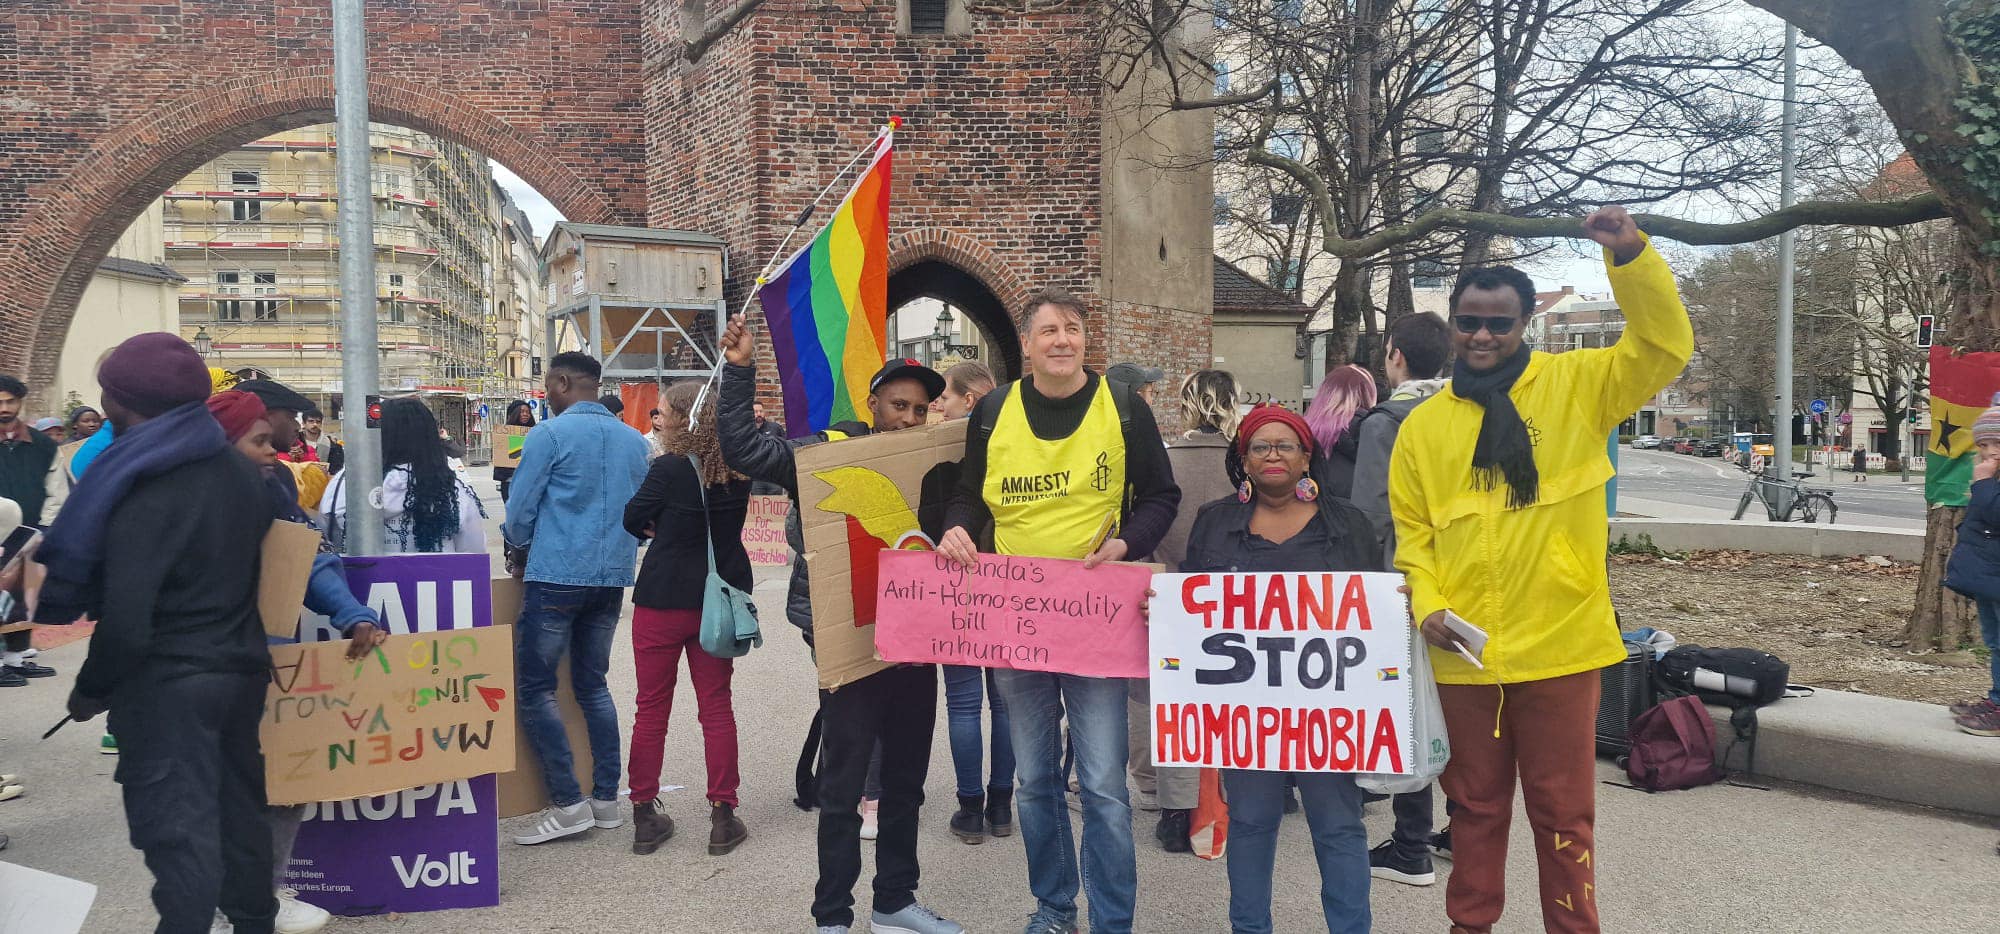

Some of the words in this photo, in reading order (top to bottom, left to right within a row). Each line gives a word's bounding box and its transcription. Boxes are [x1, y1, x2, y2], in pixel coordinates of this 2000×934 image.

[1001, 470, 1070, 494] AMNESTY
[1181, 574, 1373, 631] GHANA
[952, 610, 986, 631] bill
[1017, 617, 1037, 636] is
[932, 635, 1049, 664] inhuman
[1195, 632, 1367, 691] STOP
[1156, 703, 1404, 773] HOMOPHOBIA
[301, 870, 324, 878] Ideen
[390, 851, 479, 889] Volt
[290, 882, 320, 891] starkes
[321, 883, 354, 893] Europa.
